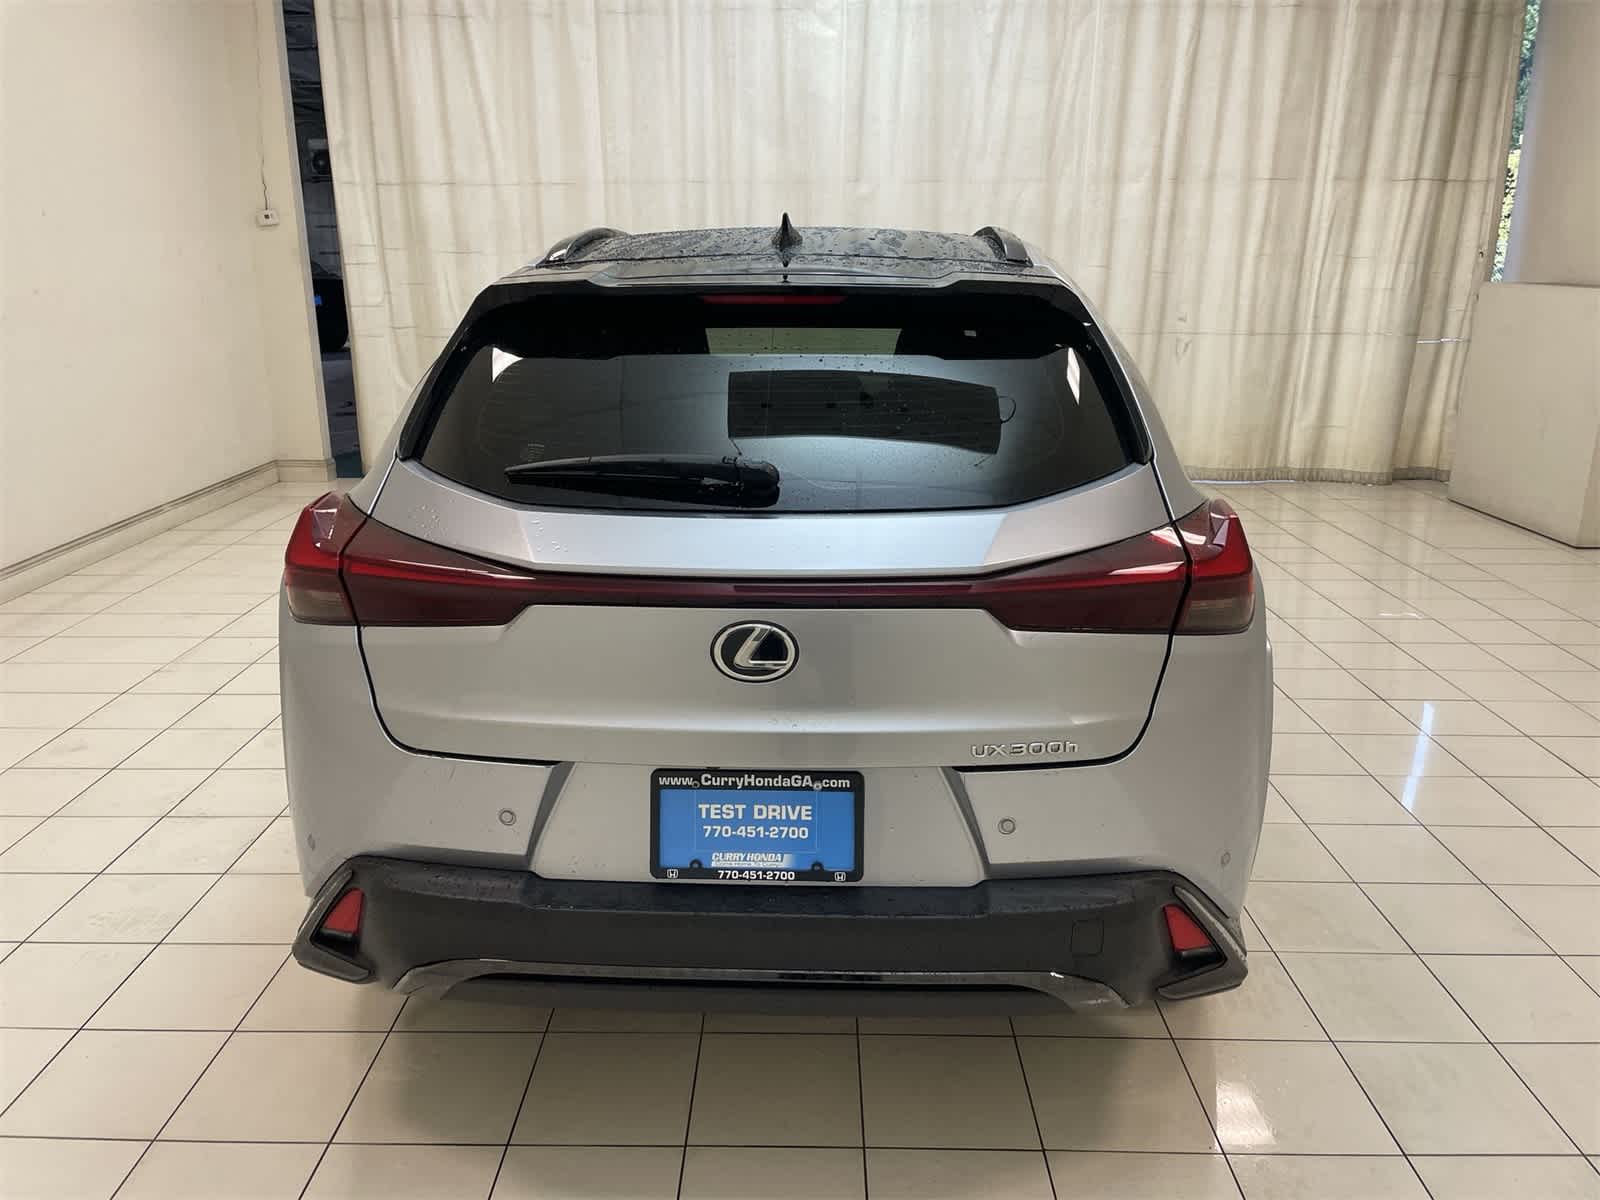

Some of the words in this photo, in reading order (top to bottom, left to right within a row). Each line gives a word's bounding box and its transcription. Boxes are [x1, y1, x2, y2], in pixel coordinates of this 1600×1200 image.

[971, 741, 1079, 758] UX300h
[658, 774, 851, 789] wwwCurryHondaGAcom
[698, 804, 746, 820] TEST
[753, 804, 813, 821] DRIVE
[703, 826, 809, 839] 770-451-2700
[711, 852, 746, 862] CURRY
[746, 853, 782, 862] HONDA
[718, 870, 796, 881] 770-451-2700
